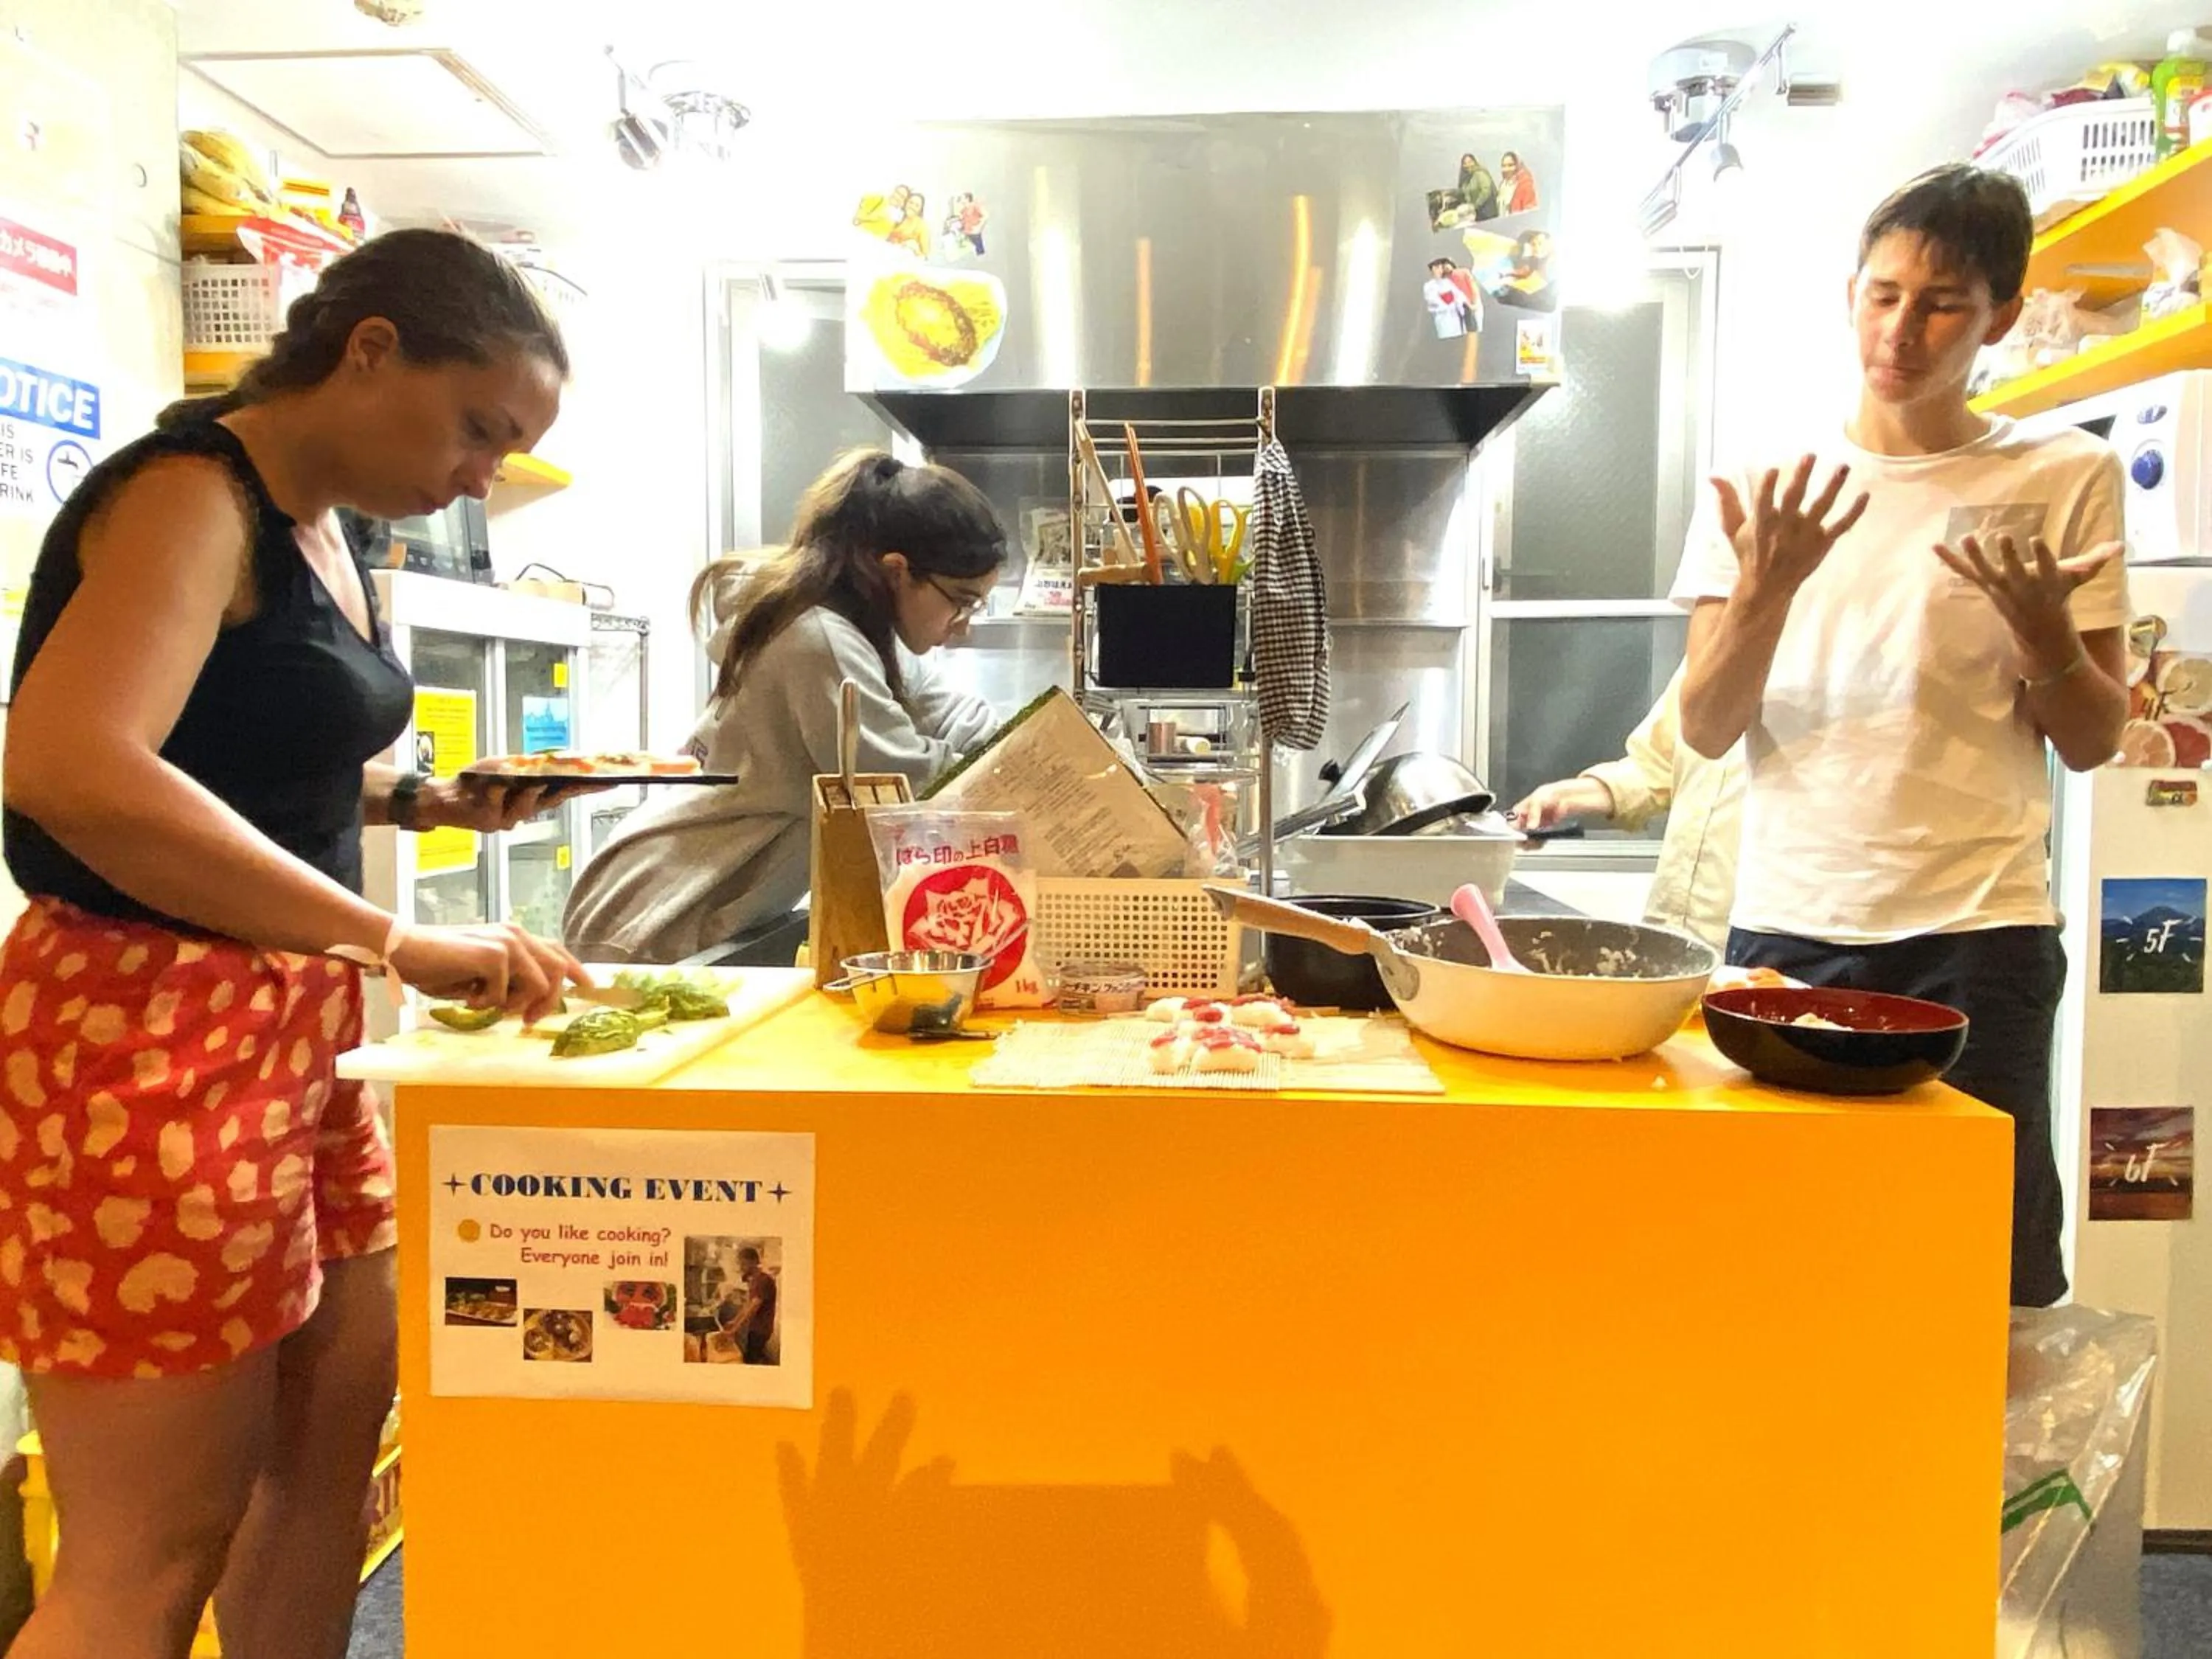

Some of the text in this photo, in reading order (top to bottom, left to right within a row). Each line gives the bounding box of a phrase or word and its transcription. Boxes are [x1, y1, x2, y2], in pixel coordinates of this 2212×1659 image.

[21, 448, 34, 465] IS
[2143, 919, 2183, 953] 5F
[471, 1173, 762, 1202] COOKING EVENT
[490, 1223, 672, 1247] Do you like cooking?
[521, 1247, 668, 1270] Everyone join in!
